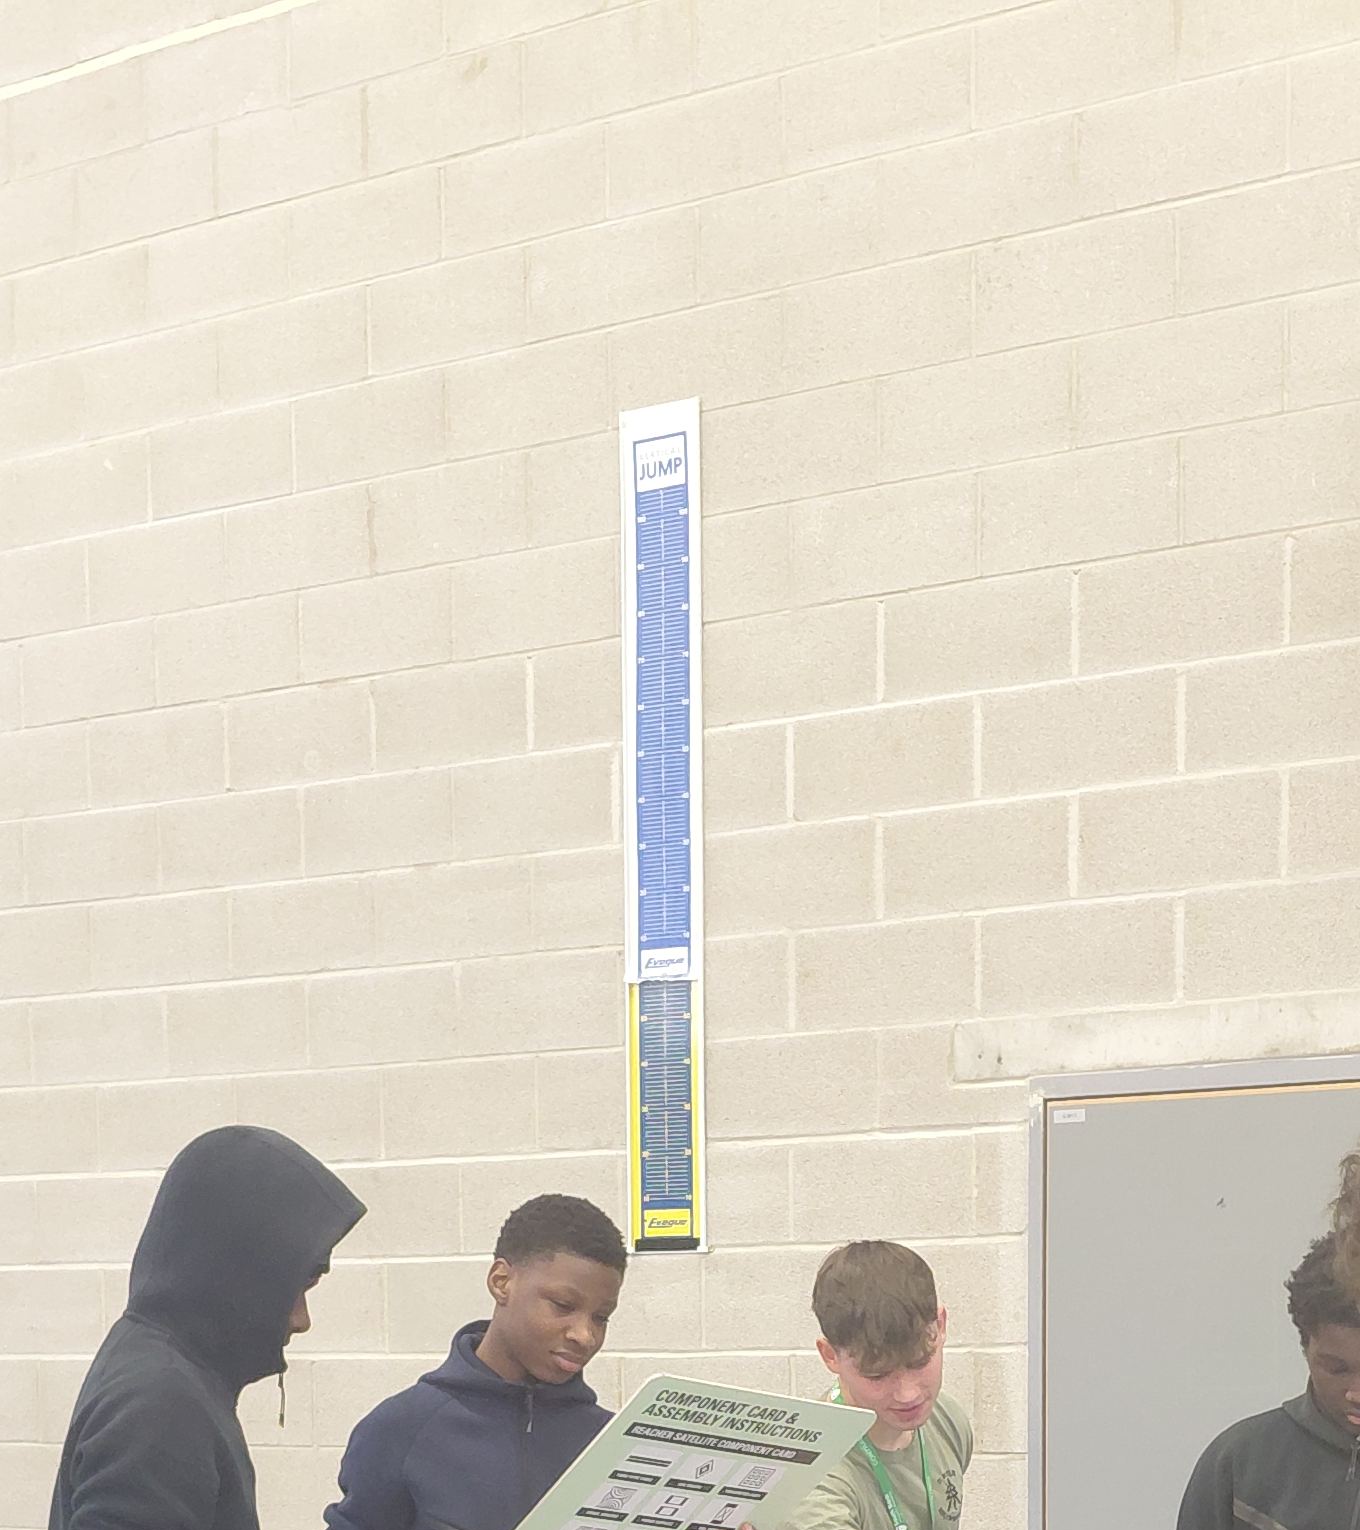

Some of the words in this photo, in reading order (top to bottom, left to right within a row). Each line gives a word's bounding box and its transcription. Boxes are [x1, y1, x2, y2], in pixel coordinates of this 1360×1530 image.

[639, 457, 683, 480] JUMP
[655, 1389, 750, 1415] COMPONENT
[748, 1405, 786, 1422] CARD
[784, 1412, 800, 1425] &
[641, 1403, 723, 1427] ASSEMBLY
[720, 1416, 822, 1443] INSTRUCTIONS
[672, 1432, 718, 1447] SATELLITE
[717, 1439, 773, 1456] COMPONENT
[771, 1448, 797, 1459] CARD
